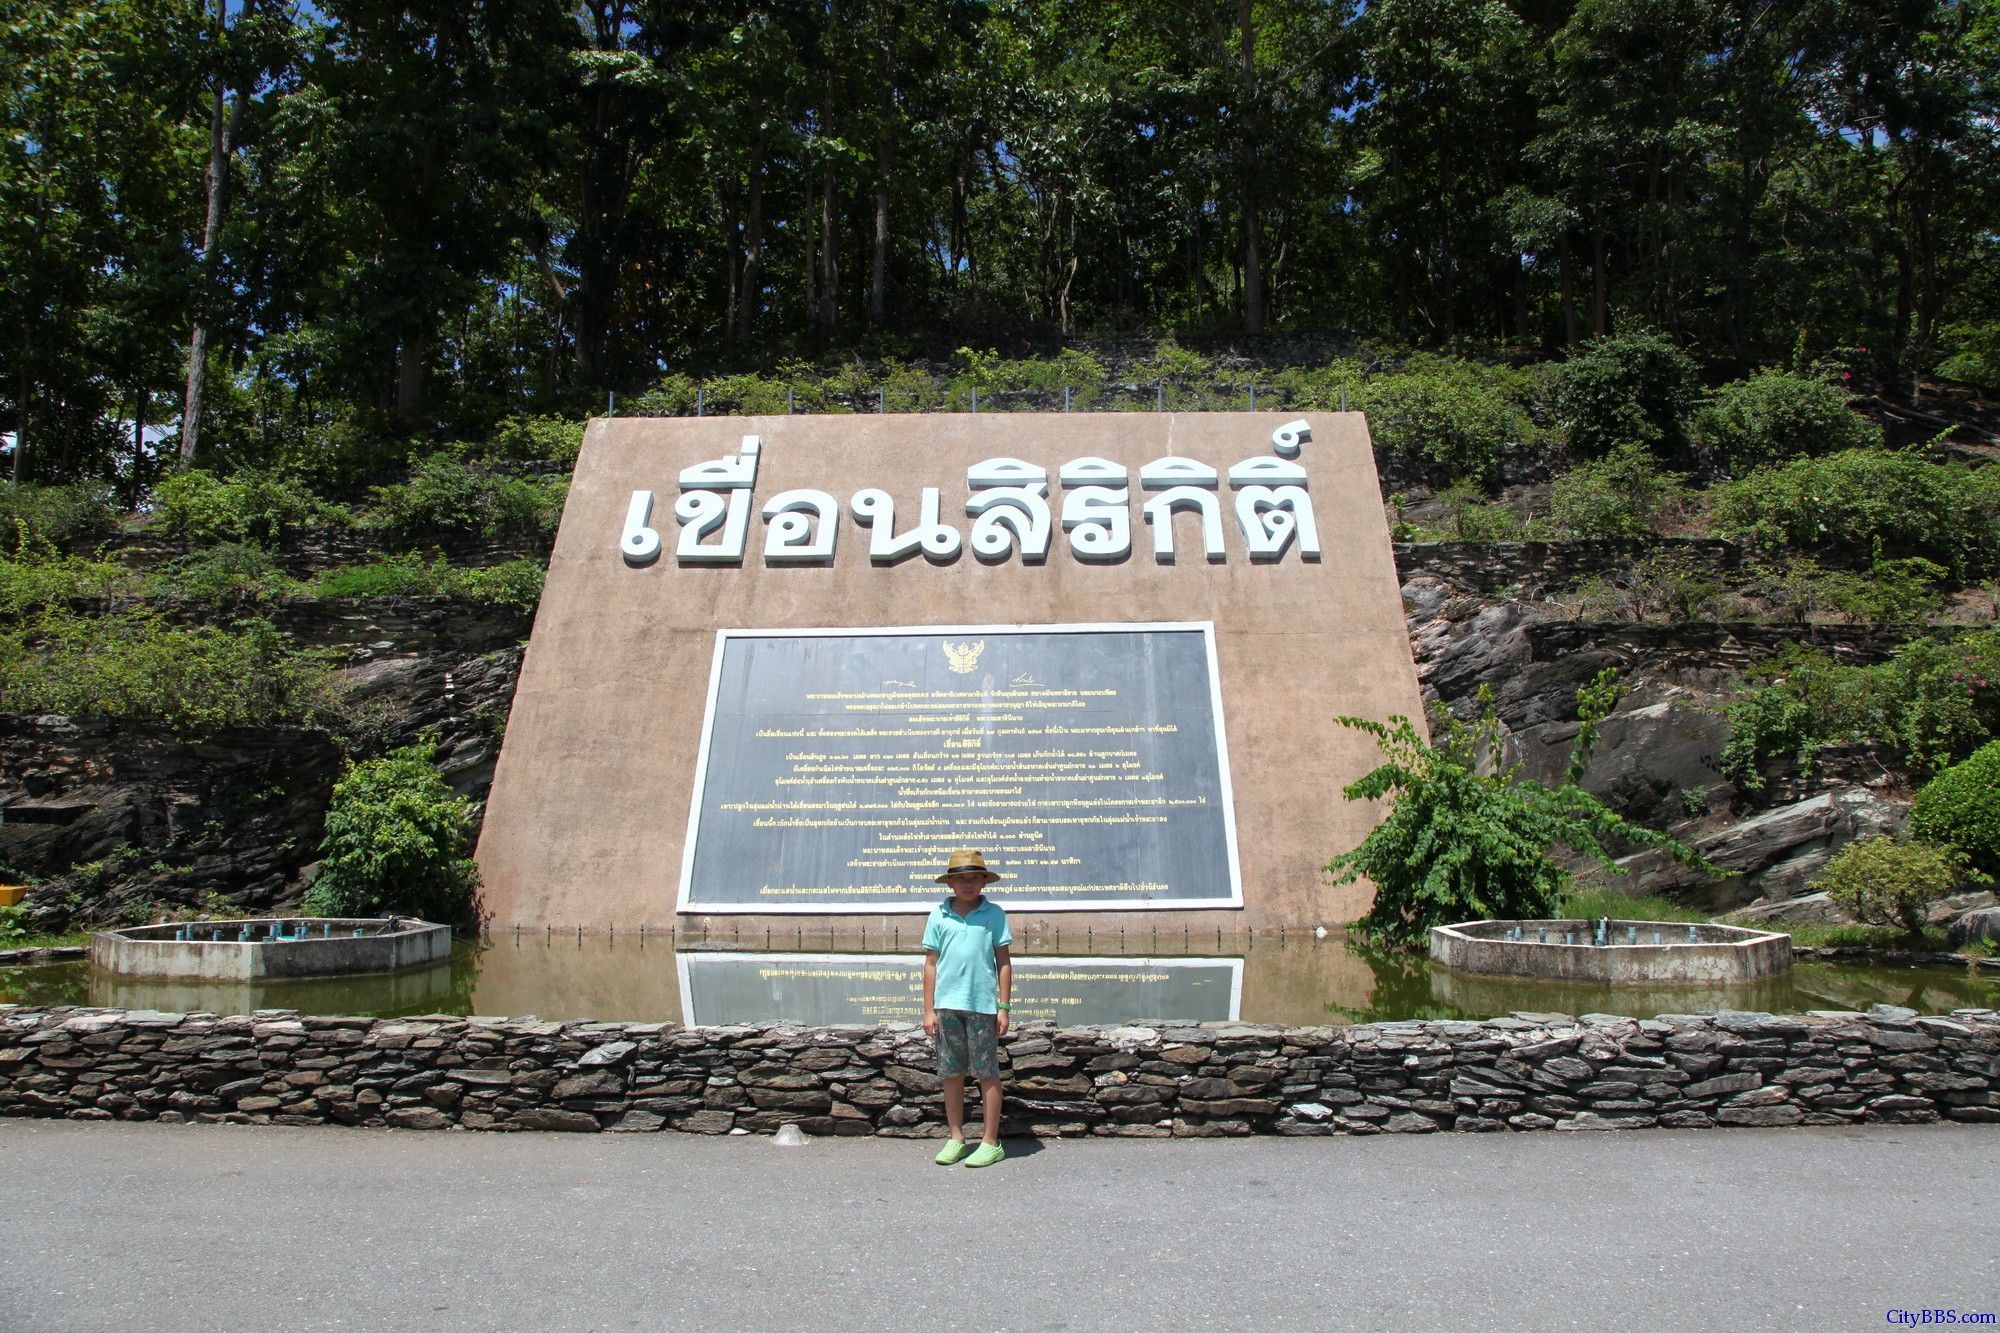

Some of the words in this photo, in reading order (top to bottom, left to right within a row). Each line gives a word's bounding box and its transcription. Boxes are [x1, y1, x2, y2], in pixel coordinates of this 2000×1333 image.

[620, 419, 1320, 563] เขื่อนสิริกิติ์
